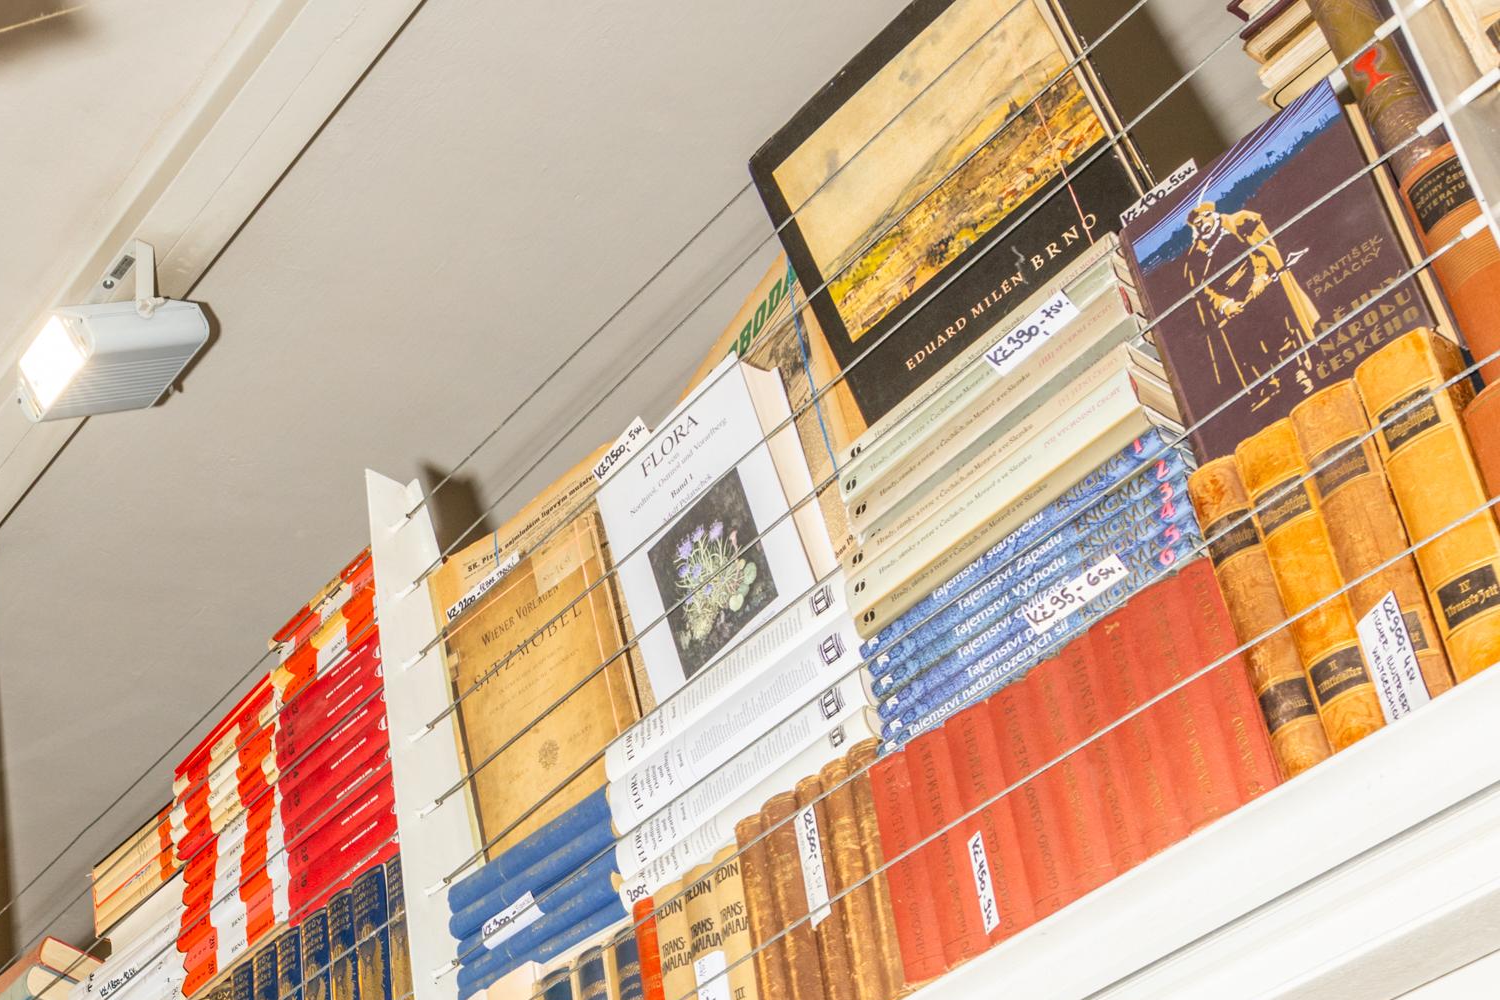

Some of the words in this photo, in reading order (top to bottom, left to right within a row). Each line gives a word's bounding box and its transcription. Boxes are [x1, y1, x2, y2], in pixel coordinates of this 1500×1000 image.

[1306, 235, 1383, 289] FRANTIŠEK
[1314, 246, 1382, 297] PALACKÝ
[905, 316, 968, 371] EDUARD
[1031, 213, 1097, 271] BRNO
[1316, 305, 1420, 379] ČESKÉHO
[1317, 287, 1412, 356] NÁRODU
[640, 415, 699, 478] FLORA
[1156, 457, 1172, 478] 2
[671, 479, 688, 498] Band
[1158, 479, 1174, 501] 3
[1159, 498, 1176, 521] 4
[931, 553, 984, 600] Tajemství
[985, 511, 1046, 560] starověku
[1159, 547, 1177, 567] 6
[1164, 523, 1181, 545] 5
[953, 593, 1012, 638] Tajemství
[1012, 554, 1068, 597] východu
[956, 569, 1014, 611] Tajemství
[1015, 532, 1064, 573] Západu
[481, 616, 516, 647] WIENER
[957, 616, 1013, 660] Tajemství
[1014, 574, 1071, 619] civilizace
[907, 697, 961, 739] Tajemství
